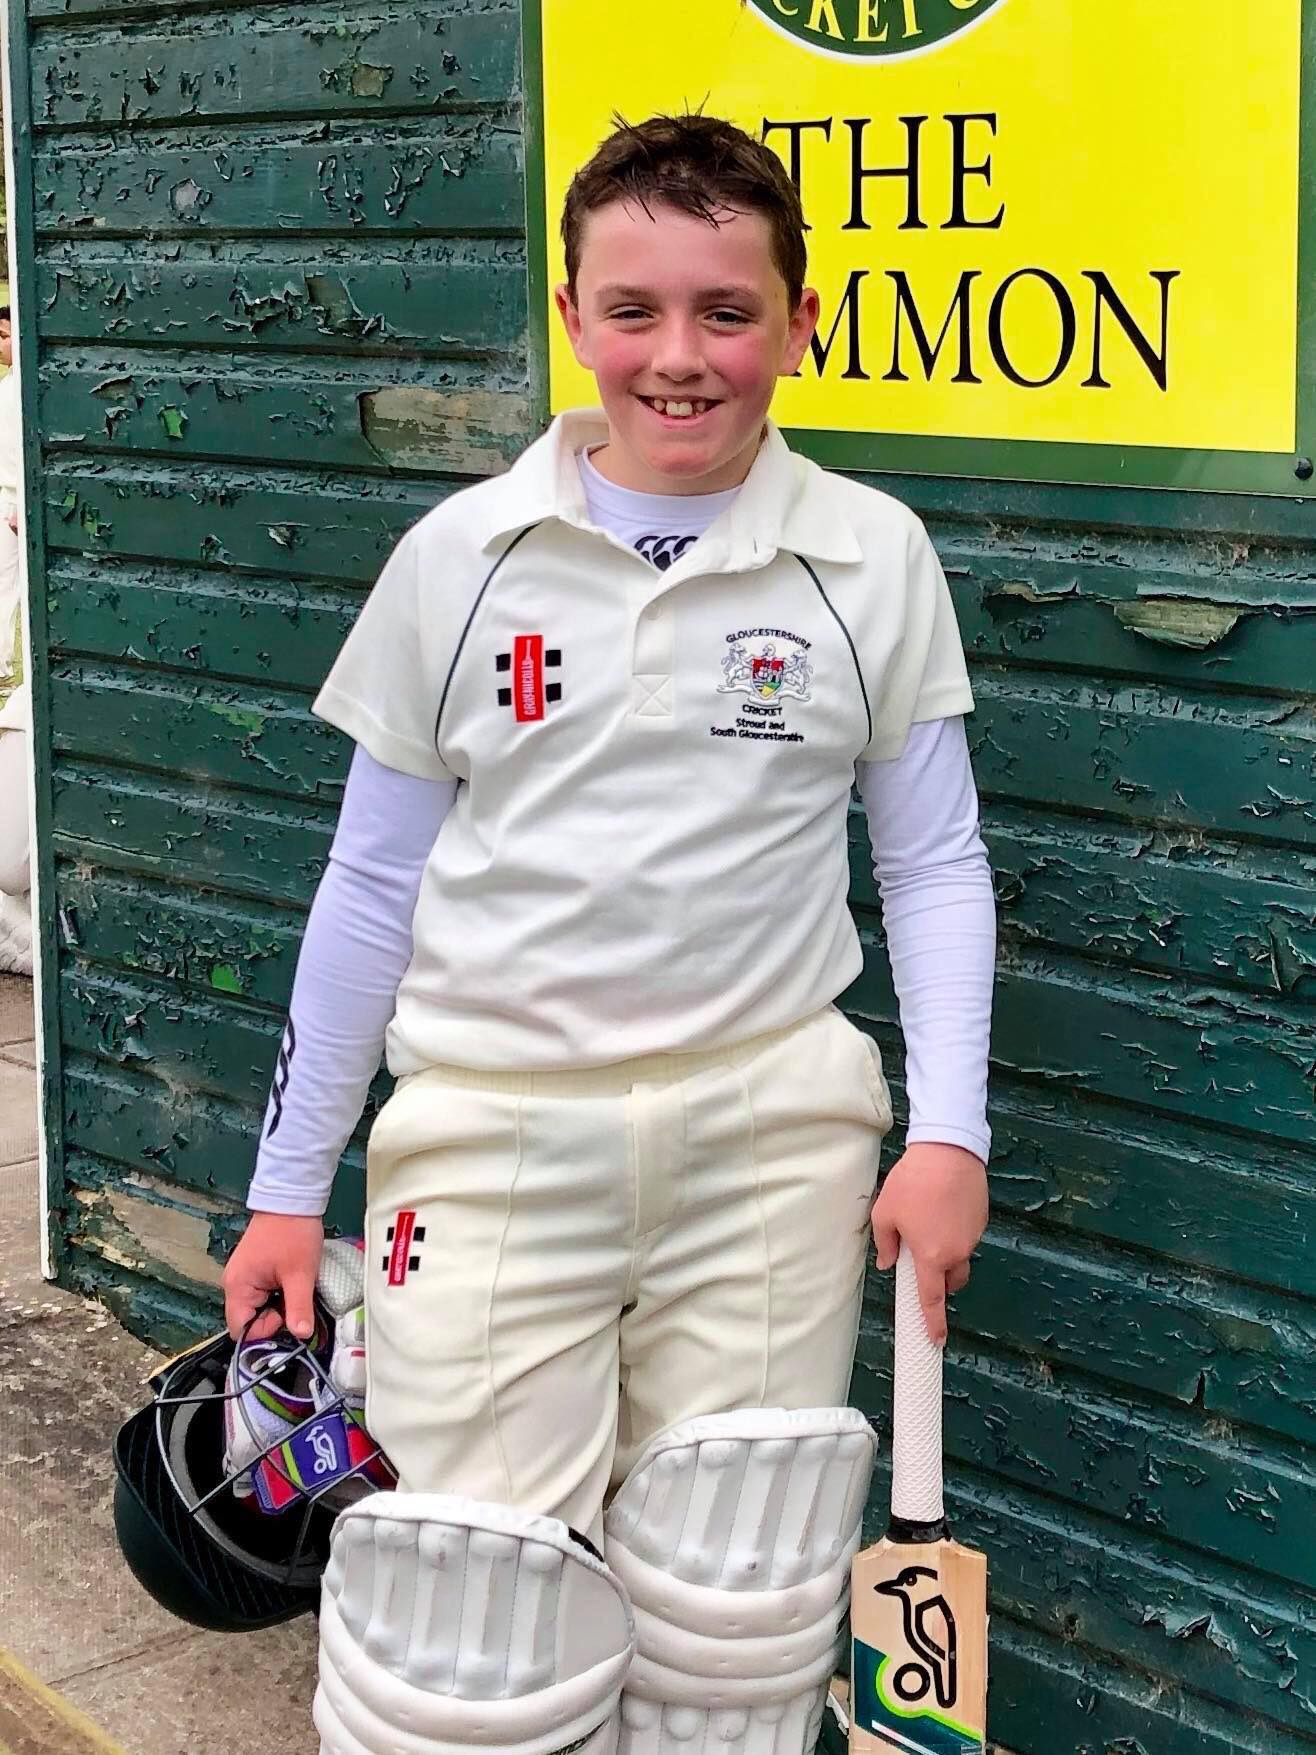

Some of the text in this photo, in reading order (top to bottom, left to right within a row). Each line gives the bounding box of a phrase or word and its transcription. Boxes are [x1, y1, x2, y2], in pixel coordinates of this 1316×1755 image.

[761, 112, 1005, 230] THE
[792, 268, 1181, 392] MMON
[726, 628, 812, 650] GLOUCESTERSHIRE
[742, 704, 783, 716] CRICKET
[710, 726, 737, 737] South
[736, 718, 785, 731] Stroud and
